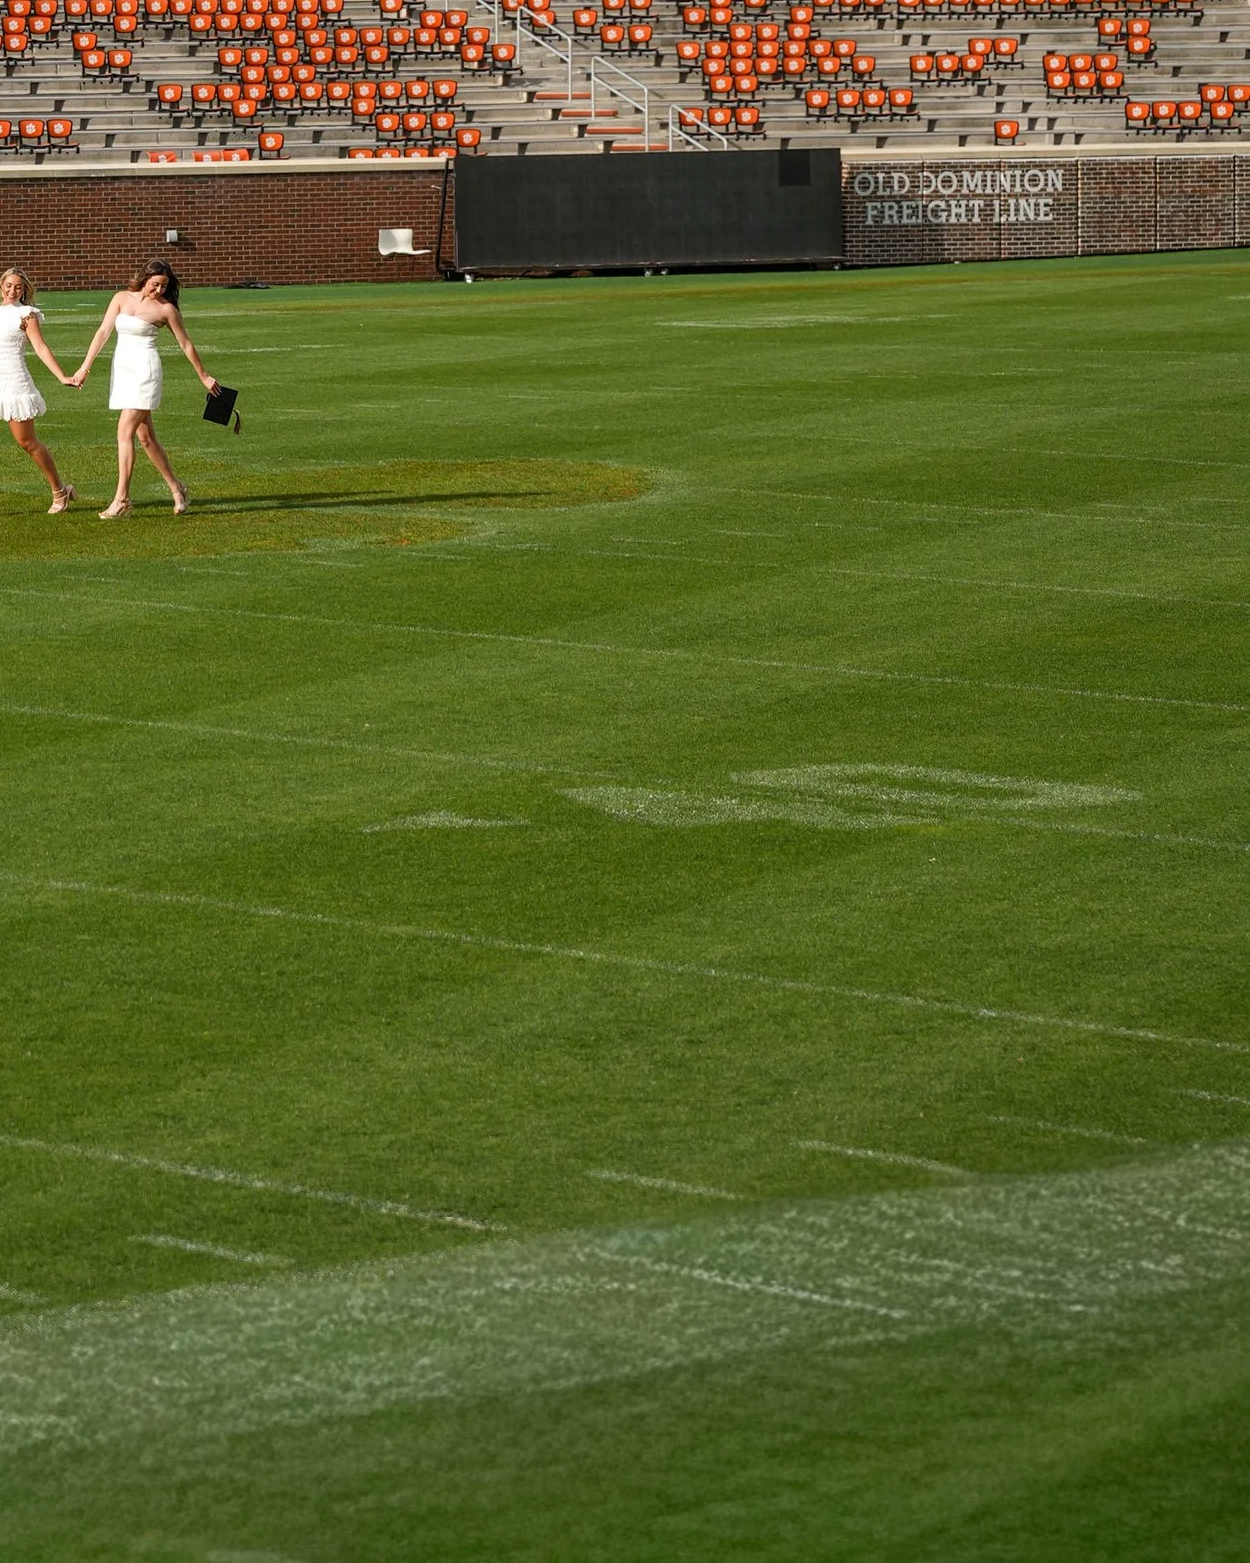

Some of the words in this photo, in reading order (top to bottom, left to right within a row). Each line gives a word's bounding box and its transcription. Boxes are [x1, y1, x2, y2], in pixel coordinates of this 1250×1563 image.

[854, 172, 910, 196] OLD
[917, 169, 1065, 195] DOMINION
[865, 200, 984, 225] FREIGHT
[993, 198, 1054, 223] LINE
